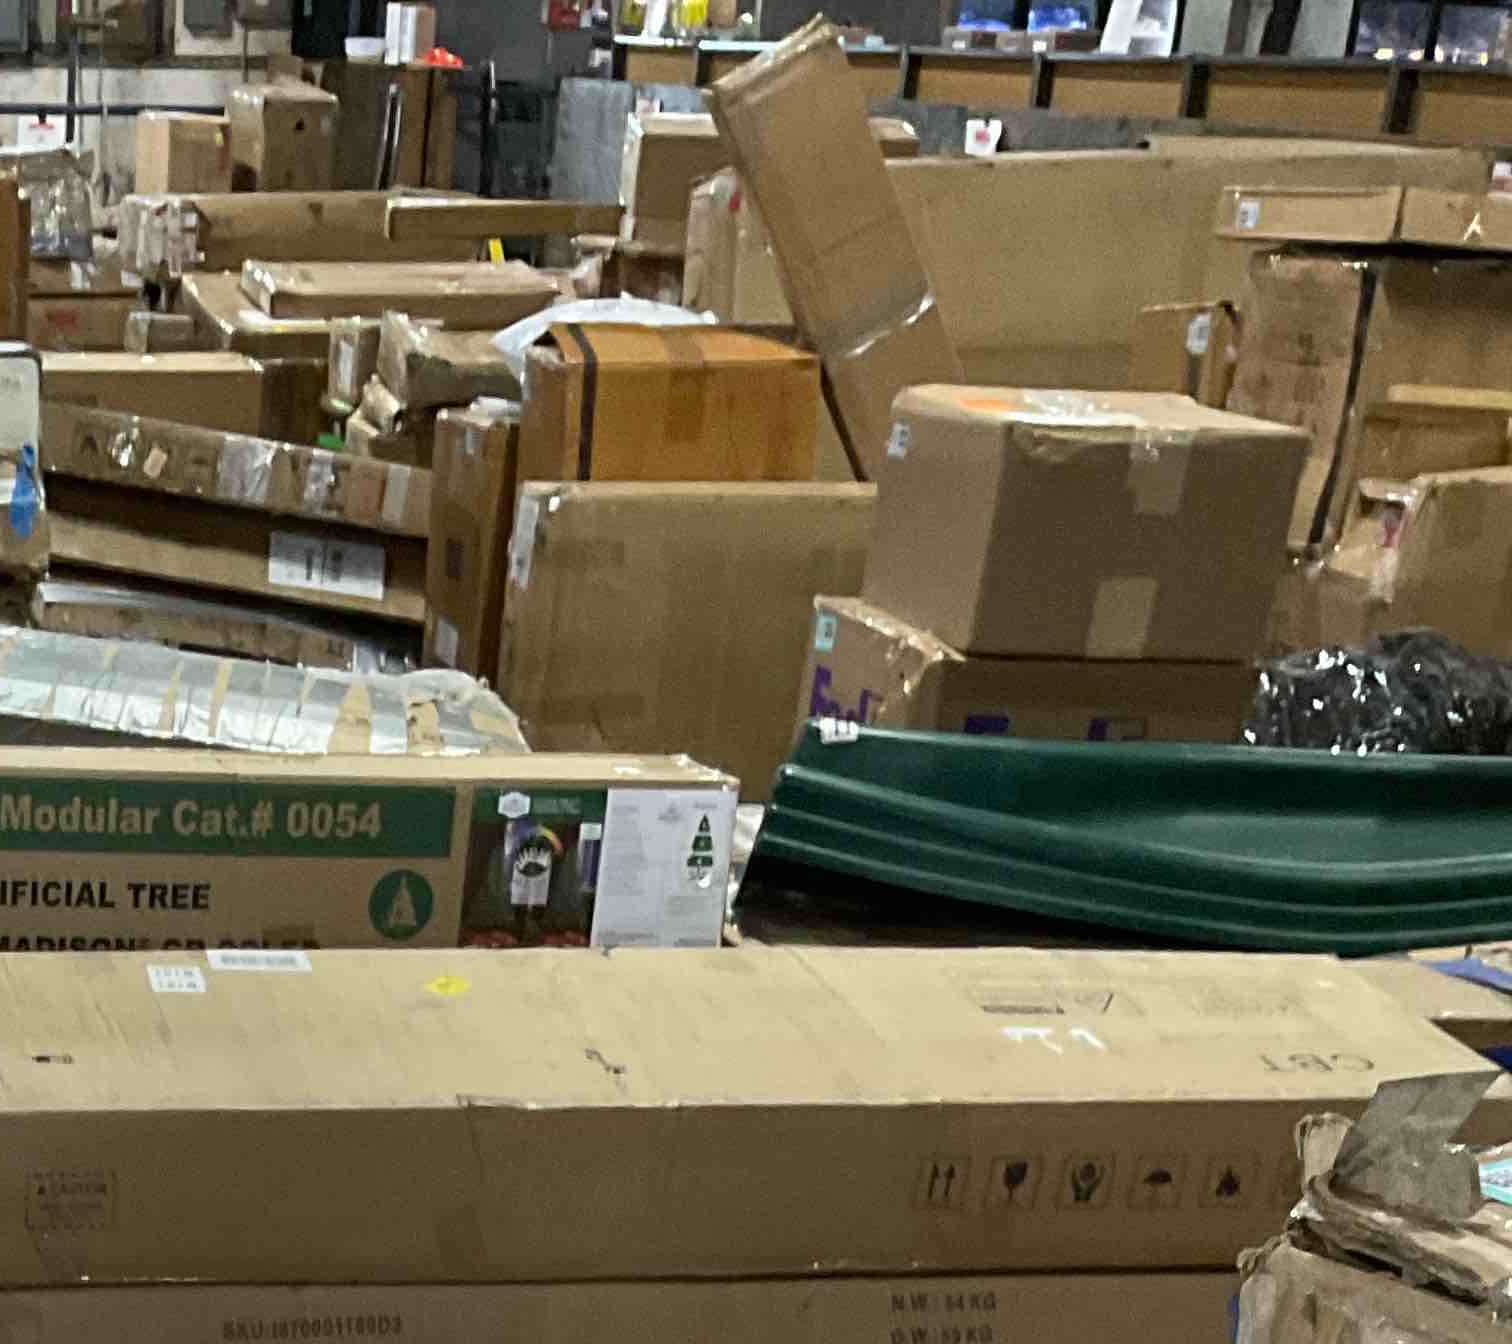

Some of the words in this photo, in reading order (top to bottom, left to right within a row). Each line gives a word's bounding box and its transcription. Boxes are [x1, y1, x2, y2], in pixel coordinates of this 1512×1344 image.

[172, 797, 273, 838] Cat.#
[286, 801, 383, 839] 0054
[128, 882, 211, 911] TREE
